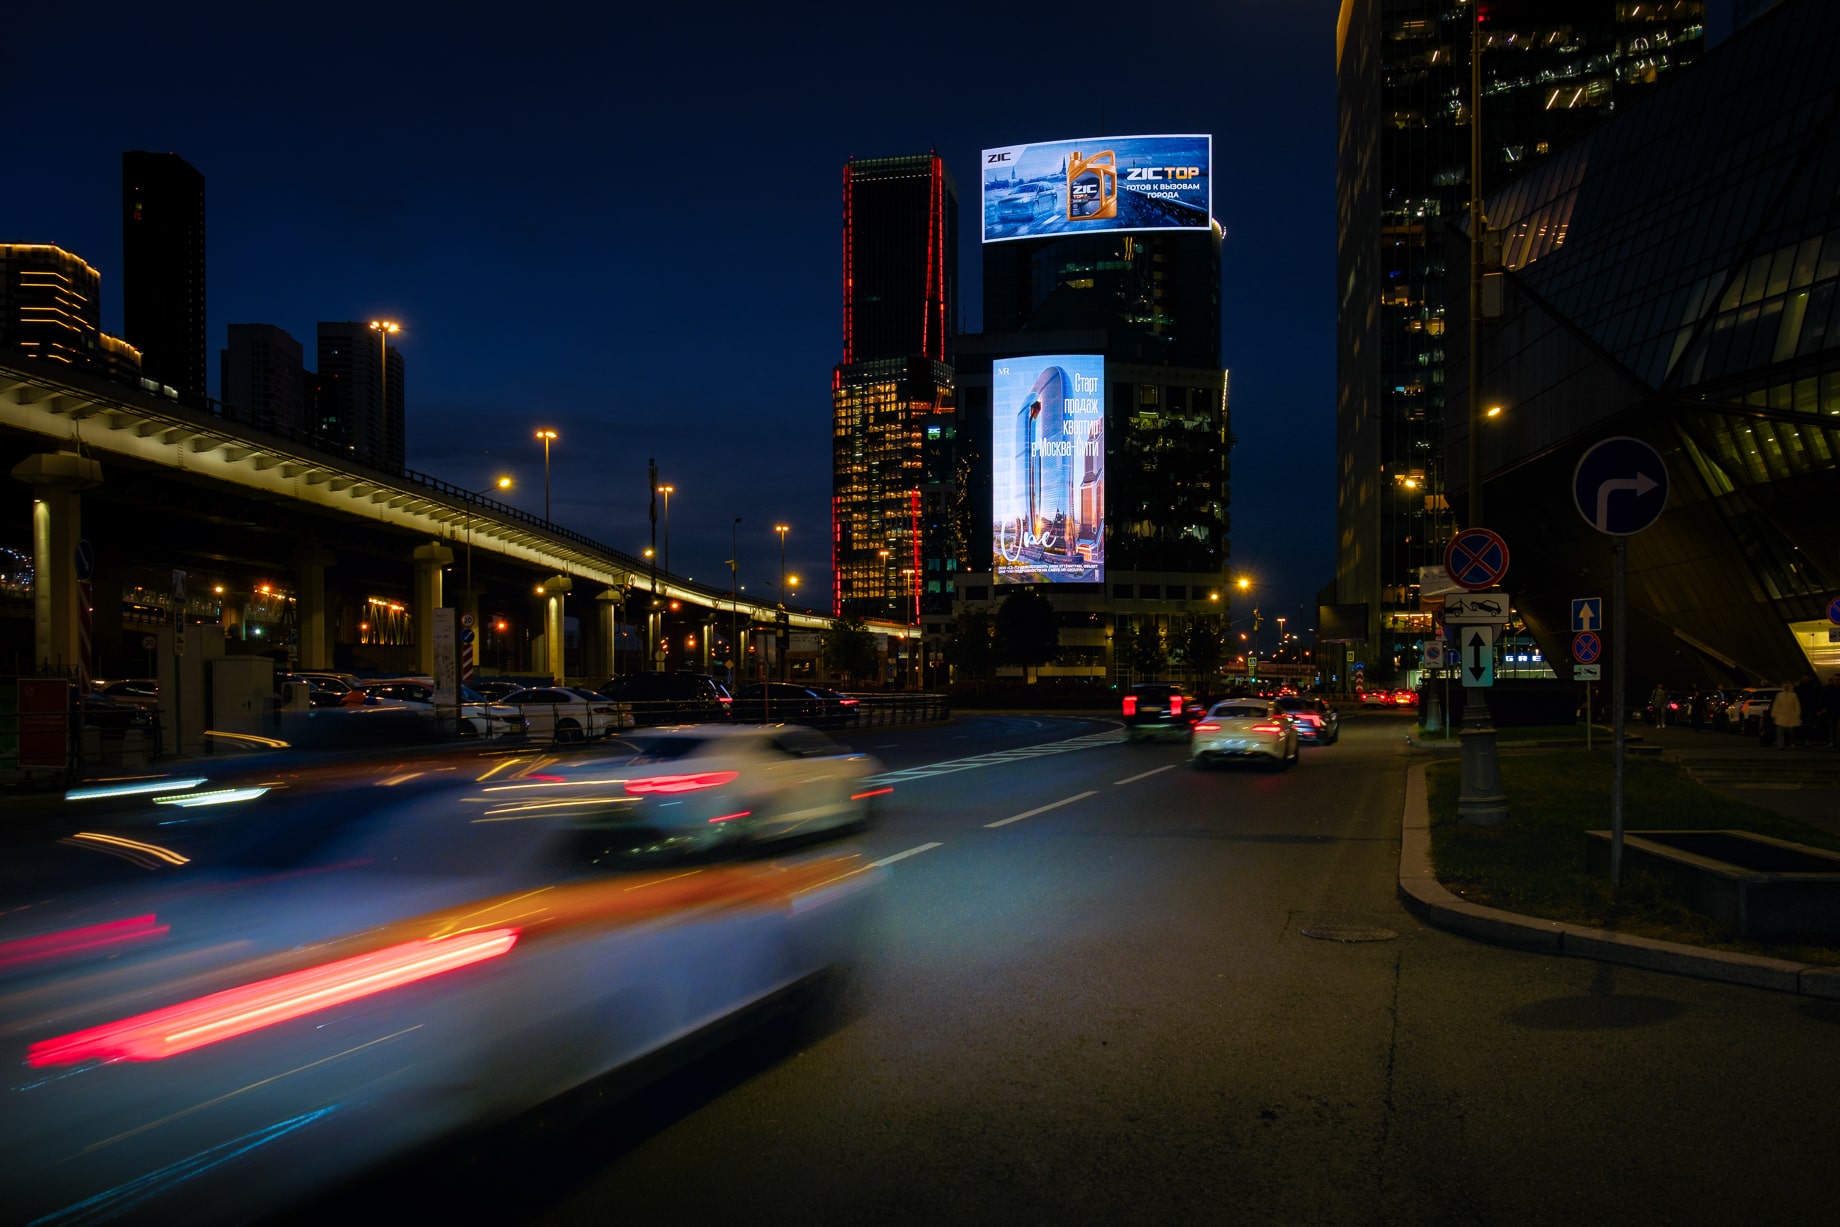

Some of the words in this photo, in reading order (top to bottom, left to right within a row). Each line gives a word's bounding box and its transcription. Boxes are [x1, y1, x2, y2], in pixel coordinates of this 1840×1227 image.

[987, 152, 1011, 163] ZIC
[1126, 167, 1163, 180] ZIC
[1164, 167, 1200, 180] TOP
[1072, 184, 1098, 195] ZIC
[1147, 191, 1179, 199] ГОРОДА
[1074, 372, 1099, 395] Старт
[1064, 398, 1099, 417] продаж
[1063, 420, 1099, 438] квартир
[1031, 442, 1037, 457] в
[1040, 437, 1099, 457] Москва-Сити
[1001, 512, 1057, 561] One
